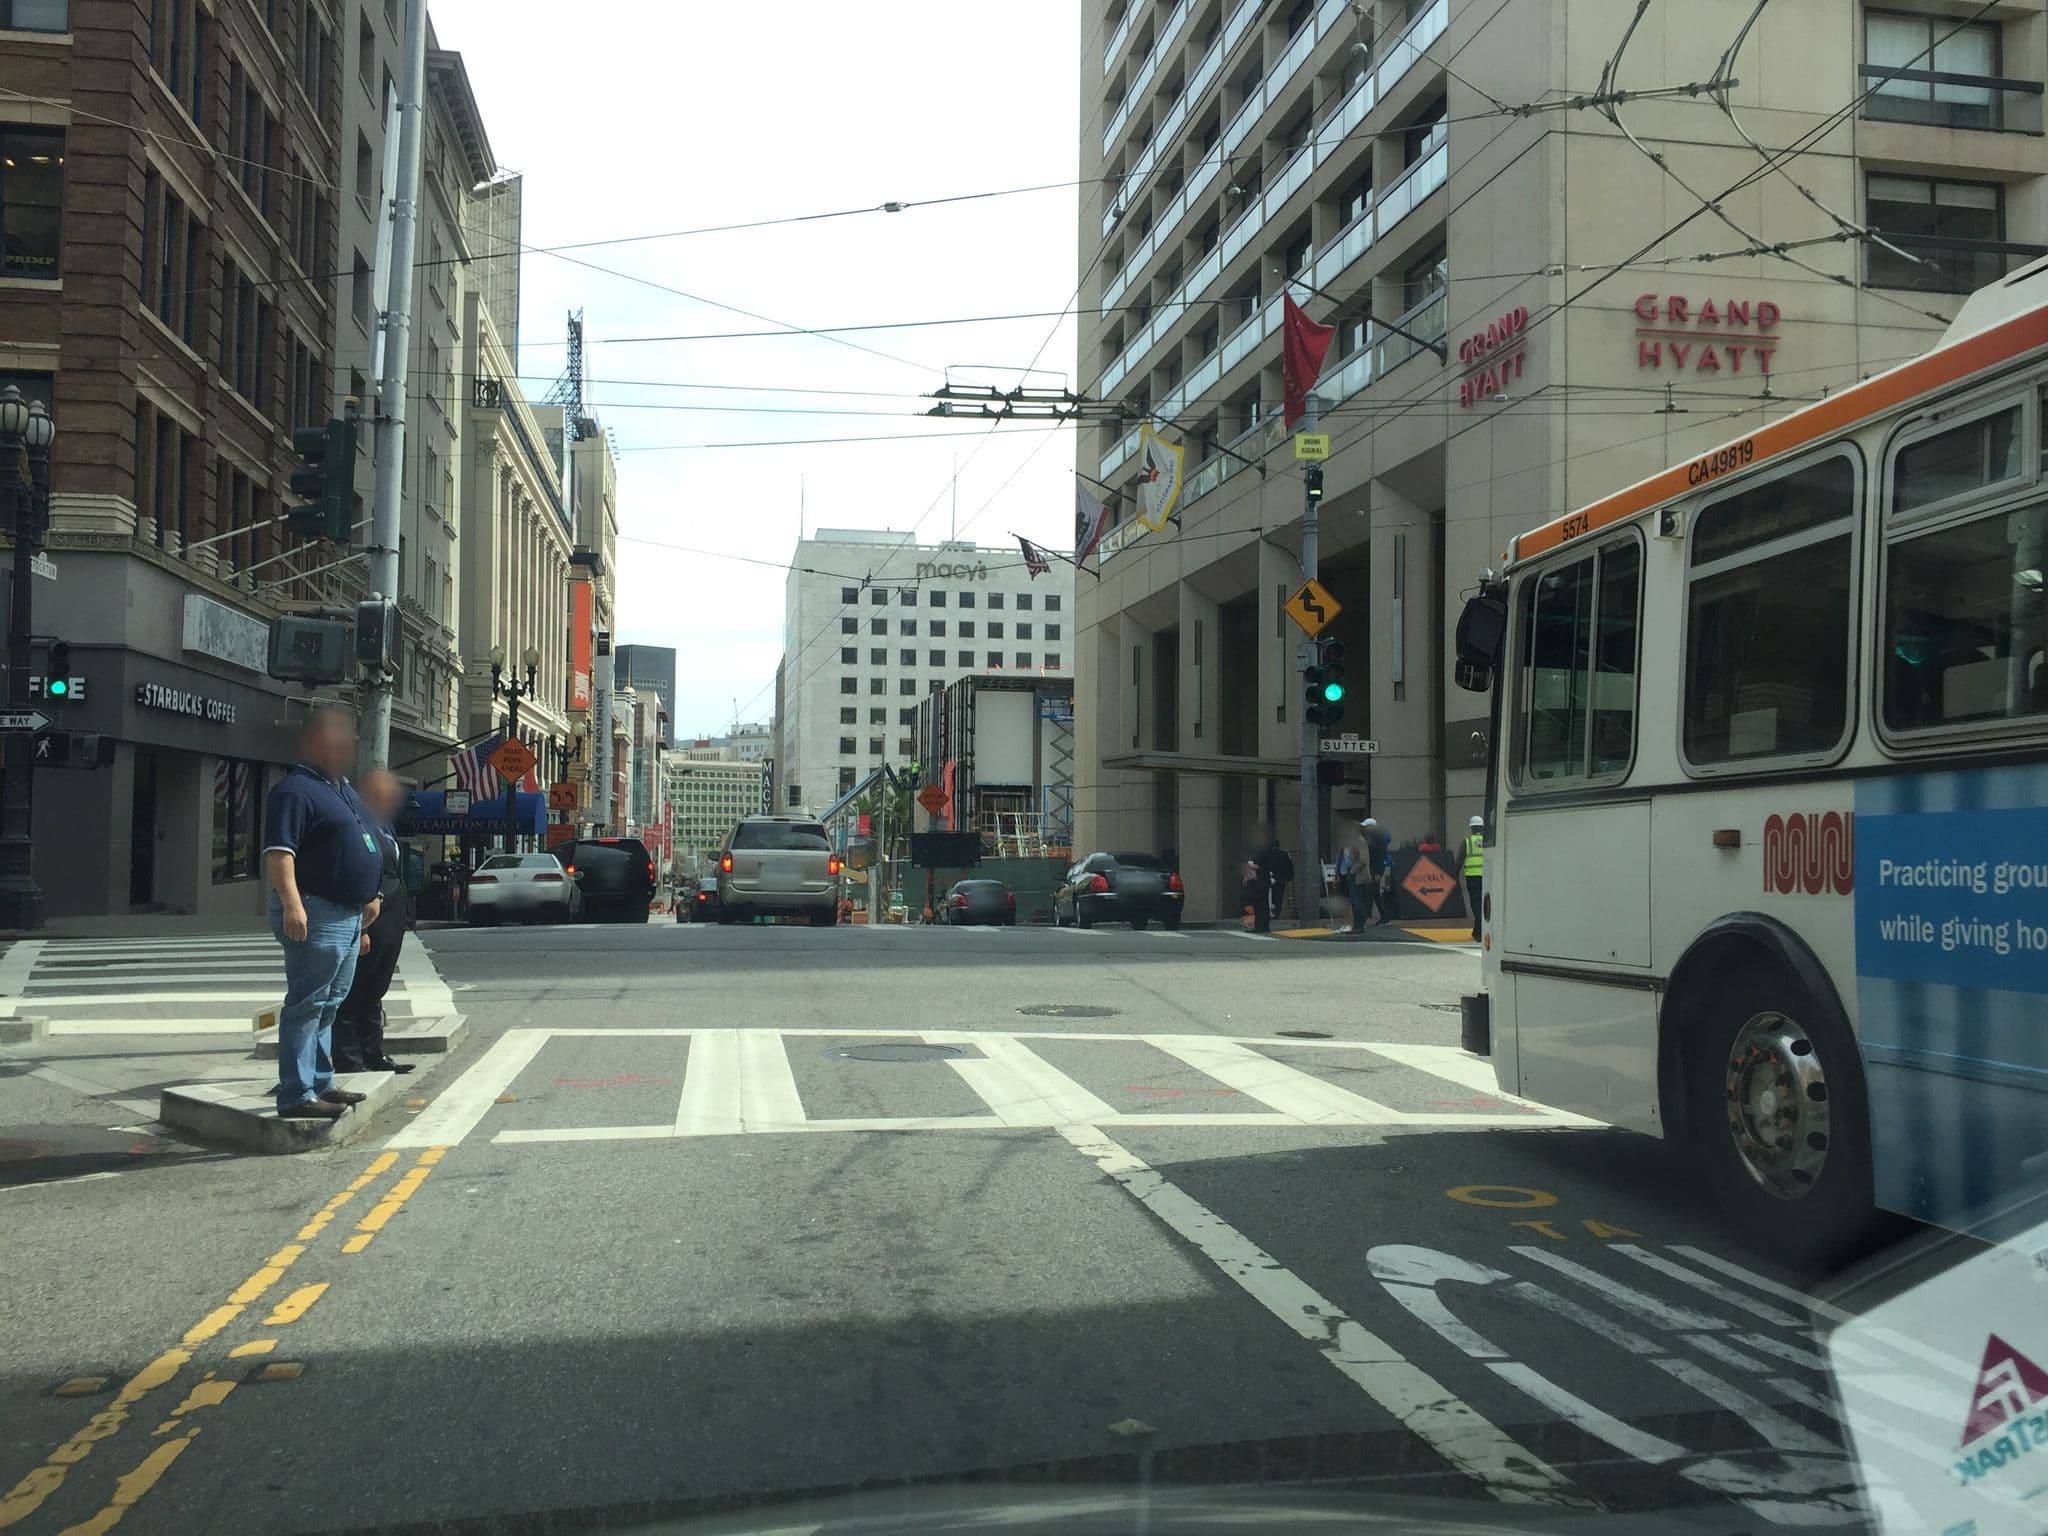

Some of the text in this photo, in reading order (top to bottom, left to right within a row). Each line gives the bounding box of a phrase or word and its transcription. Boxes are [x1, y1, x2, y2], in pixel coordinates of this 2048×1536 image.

[1635, 294, 1781, 329] GRAND
[1459, 306, 1529, 364] GRAND
[1638, 341, 1776, 373] HYATT
[1459, 350, 1526, 408] HYATT
[1562, 513, 1589, 541] 5574
[144, 682, 203, 717] STARBUCKS
[206, 698, 236, 723] COFFEE
[595, 689, 605, 744] JOHNSTON
[9, 717, 30, 726] WAY
[1323, 741, 1376, 751] SUTTER
[501, 765, 524, 773] AHEAD
[594, 755, 605, 802] MURPHY
[423, 818, 482, 831] CAMPTON
[487, 818, 521, 831] PLAE
[1879, 859, 2048, 895] Practicing grou
[1880, 915, 2048, 955] while giving ho
